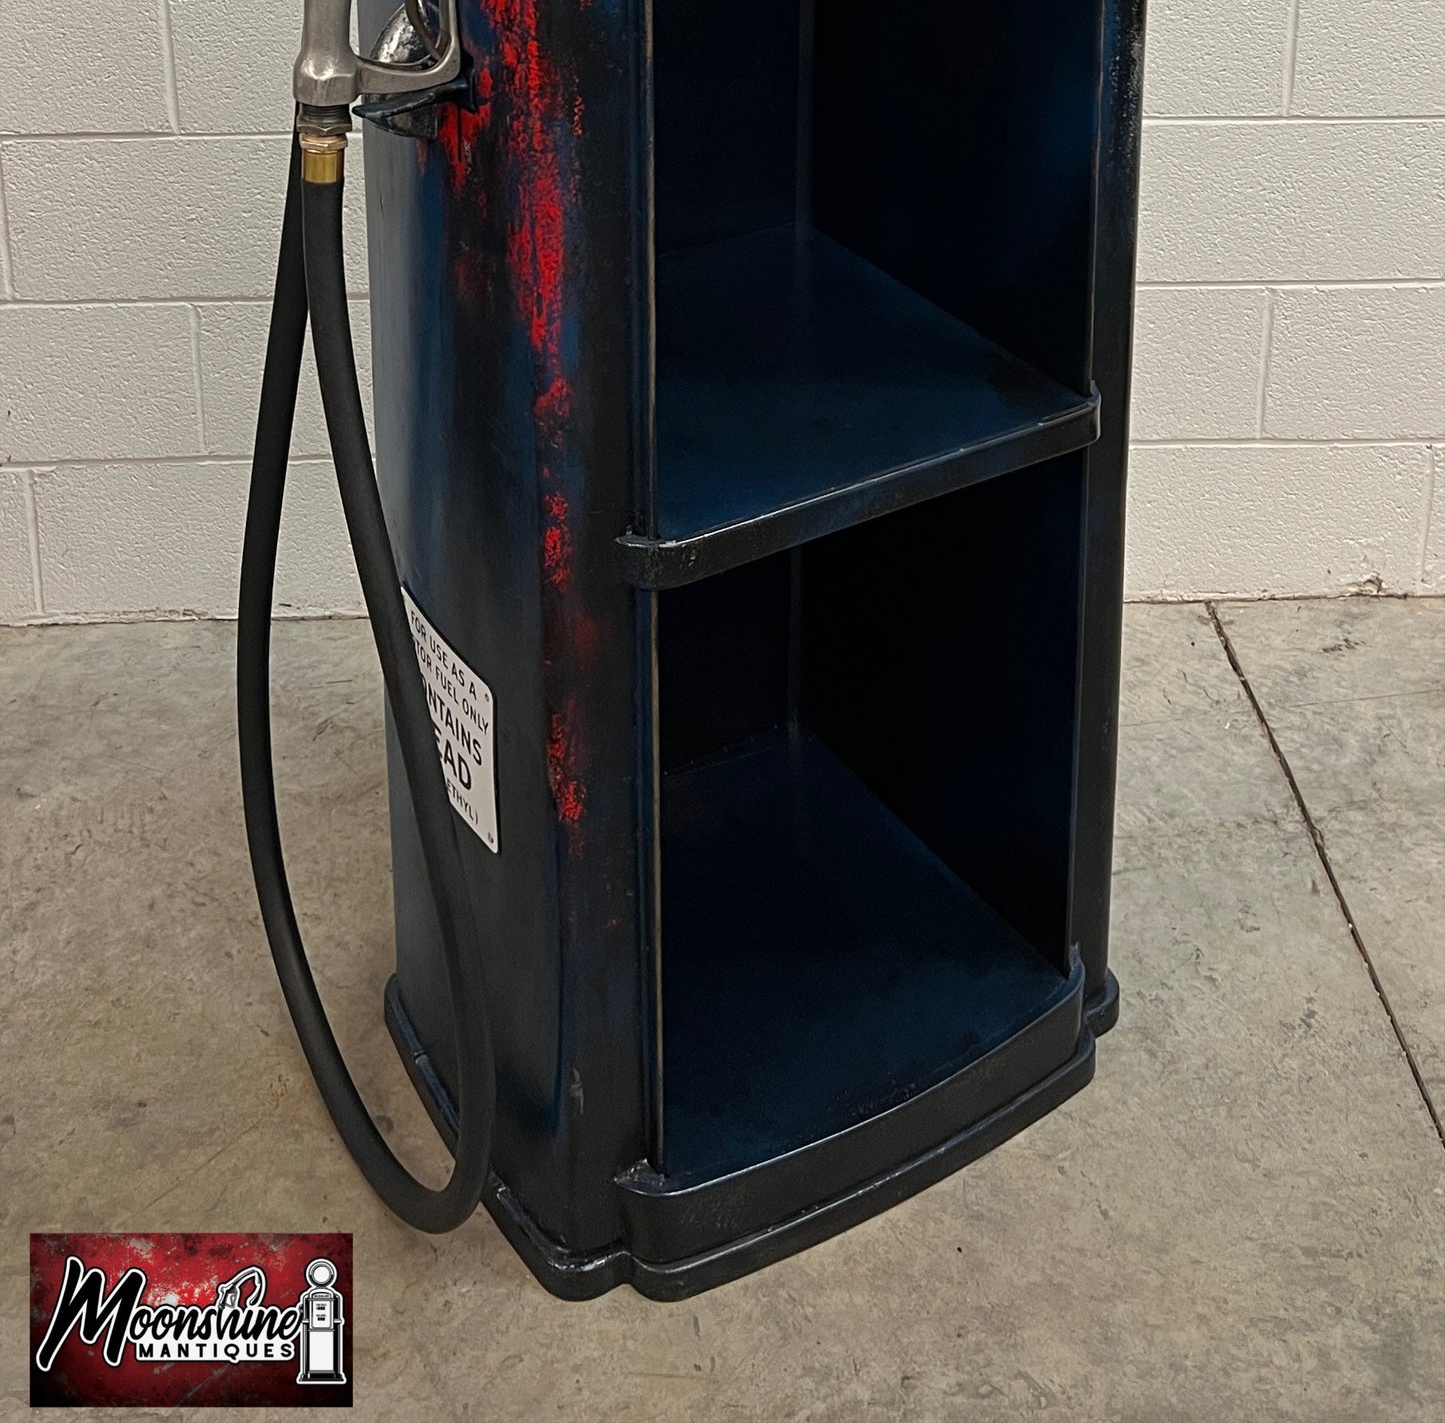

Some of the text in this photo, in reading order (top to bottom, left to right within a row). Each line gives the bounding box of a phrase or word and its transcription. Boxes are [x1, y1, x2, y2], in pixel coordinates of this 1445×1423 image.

[411, 610, 477, 701] FOR USE AS A
[415, 639, 489, 735] TOR FUEL ONLY
[421, 673, 482, 766] NTAINS
[446, 778, 479, 825] ETHYL)
